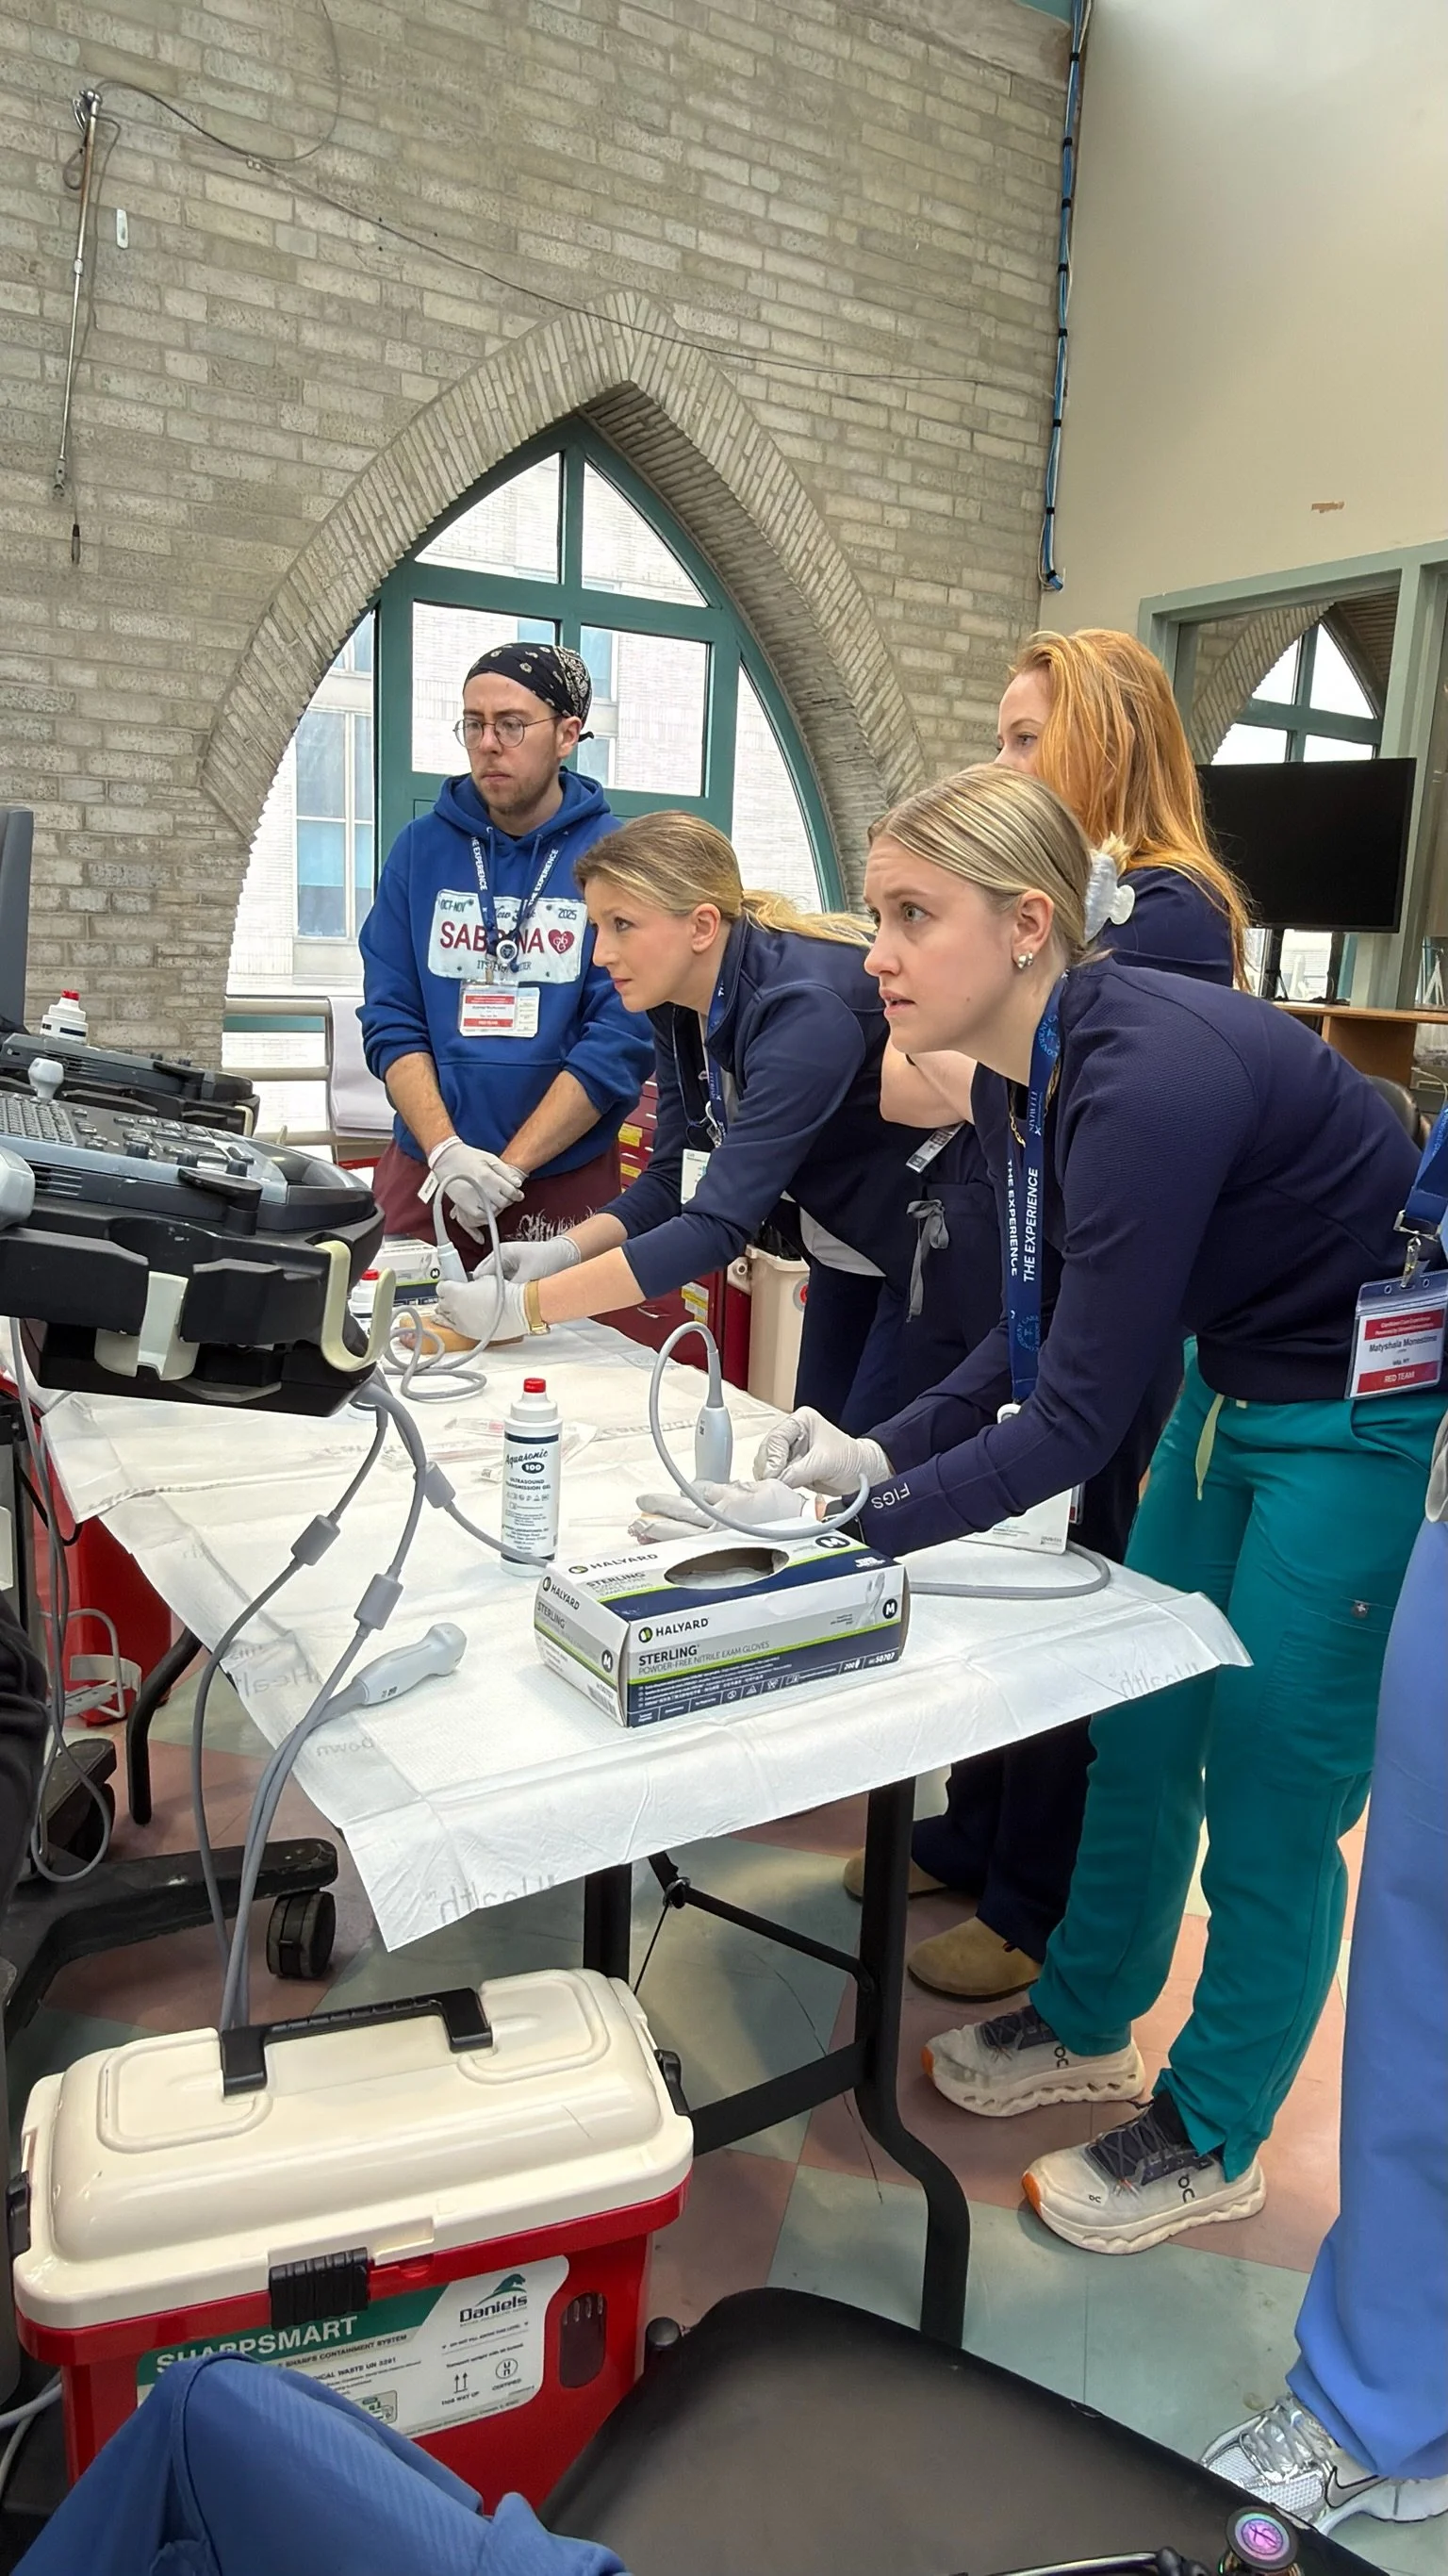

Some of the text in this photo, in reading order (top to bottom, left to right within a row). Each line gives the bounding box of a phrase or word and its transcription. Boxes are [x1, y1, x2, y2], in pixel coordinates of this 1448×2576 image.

[558, 908, 577, 920] 2025
[1008, 1190, 1018, 1277] EXPERIENCE
[1023, 1167, 1038, 1283] THE EXPERIENCE
[506, 1448, 549, 1469] Aquasonic
[871, 1482, 911, 1509] FIGS
[820, 1539, 847, 1548] M
[590, 1554, 658, 1569] HALYARD
[586, 1572, 647, 1588] STERLING
[551, 1583, 581, 1610] HALYARD
[537, 1601, 566, 1629] STERLING
[885, 1603, 896, 1615] M
[655, 1618, 709, 1637] HALYARD
[639, 1644, 698, 1667] STERLING
[639, 1641, 770, 1676] POWDER-FREE NITRILE EXAM GLOVES
[460, 2295, 528, 2322] Daniels
